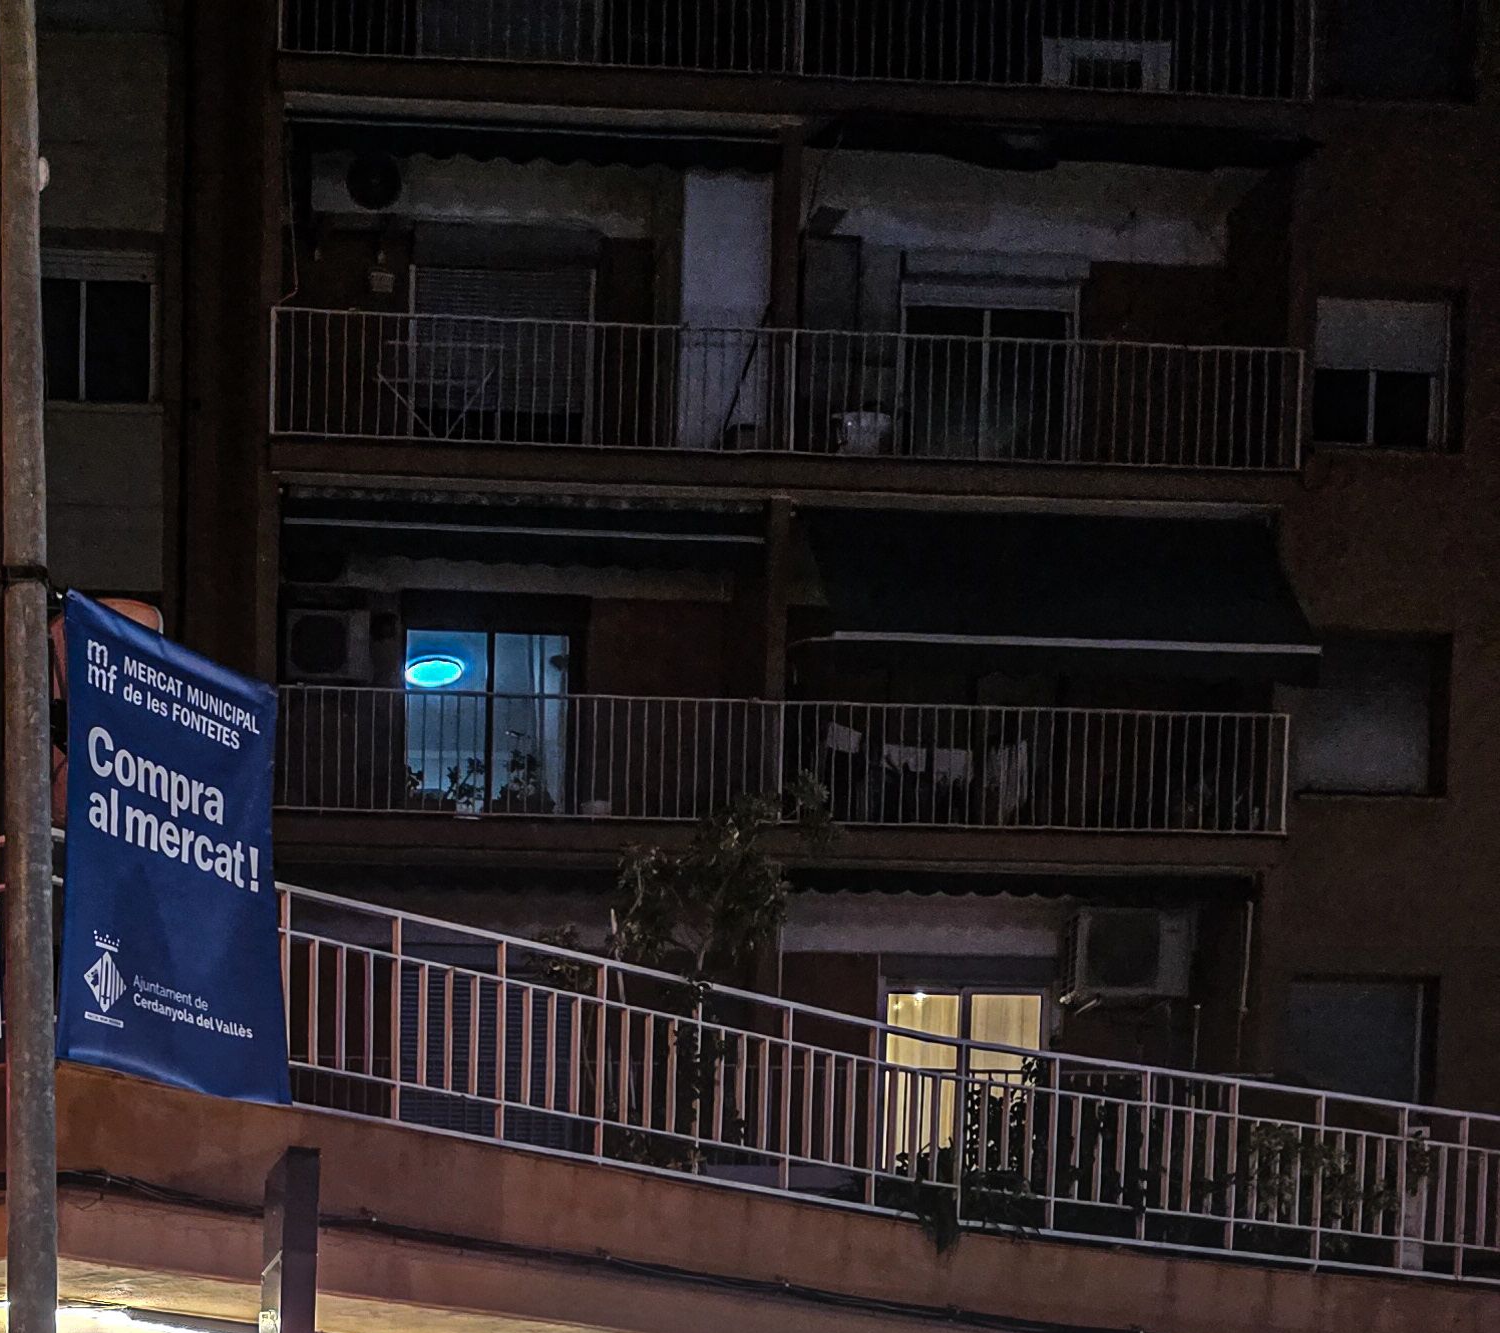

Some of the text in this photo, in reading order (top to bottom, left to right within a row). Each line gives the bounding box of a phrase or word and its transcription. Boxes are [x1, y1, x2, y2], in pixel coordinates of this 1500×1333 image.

[123, 655, 261, 735] MERCAT MUNICIPAL
[123, 683, 241, 750] de les FONTETES
[87, 726, 225, 826] Compra
[88, 788, 260, 893] al mercat!
[132, 974, 210, 1012] Ajuntament de
[132, 992, 195, 1025] Cerdanyola
[196, 1012, 215, 1032] del
[214, 1017, 254, 1040] Vallès
